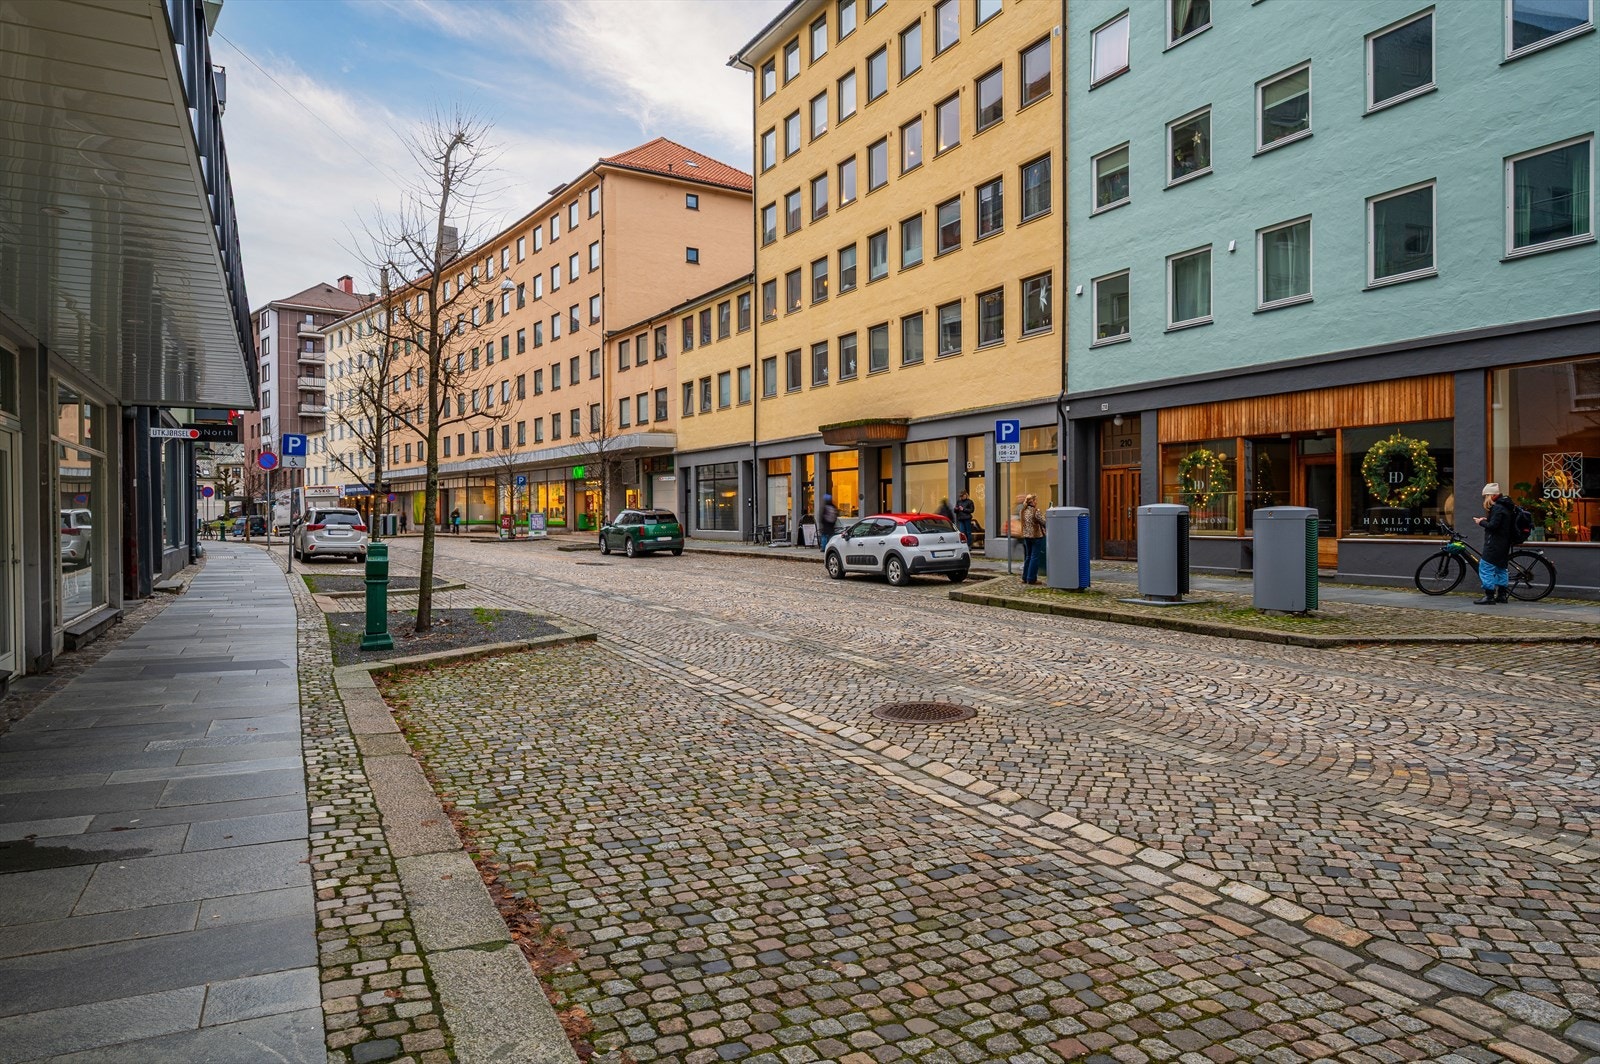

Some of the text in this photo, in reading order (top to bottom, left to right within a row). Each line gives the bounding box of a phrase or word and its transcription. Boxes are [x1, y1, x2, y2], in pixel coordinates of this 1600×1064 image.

[152, 429, 189, 437] UTKJØRSEL
[1001, 423, 1014, 441] P
[288, 437, 301, 453] P
[1120, 439, 1133, 447] 210
[1388, 471, 1404, 483] HD
[1543, 488, 1582, 499] SOUK
[1363, 517, 1431, 525] HAMILTON
